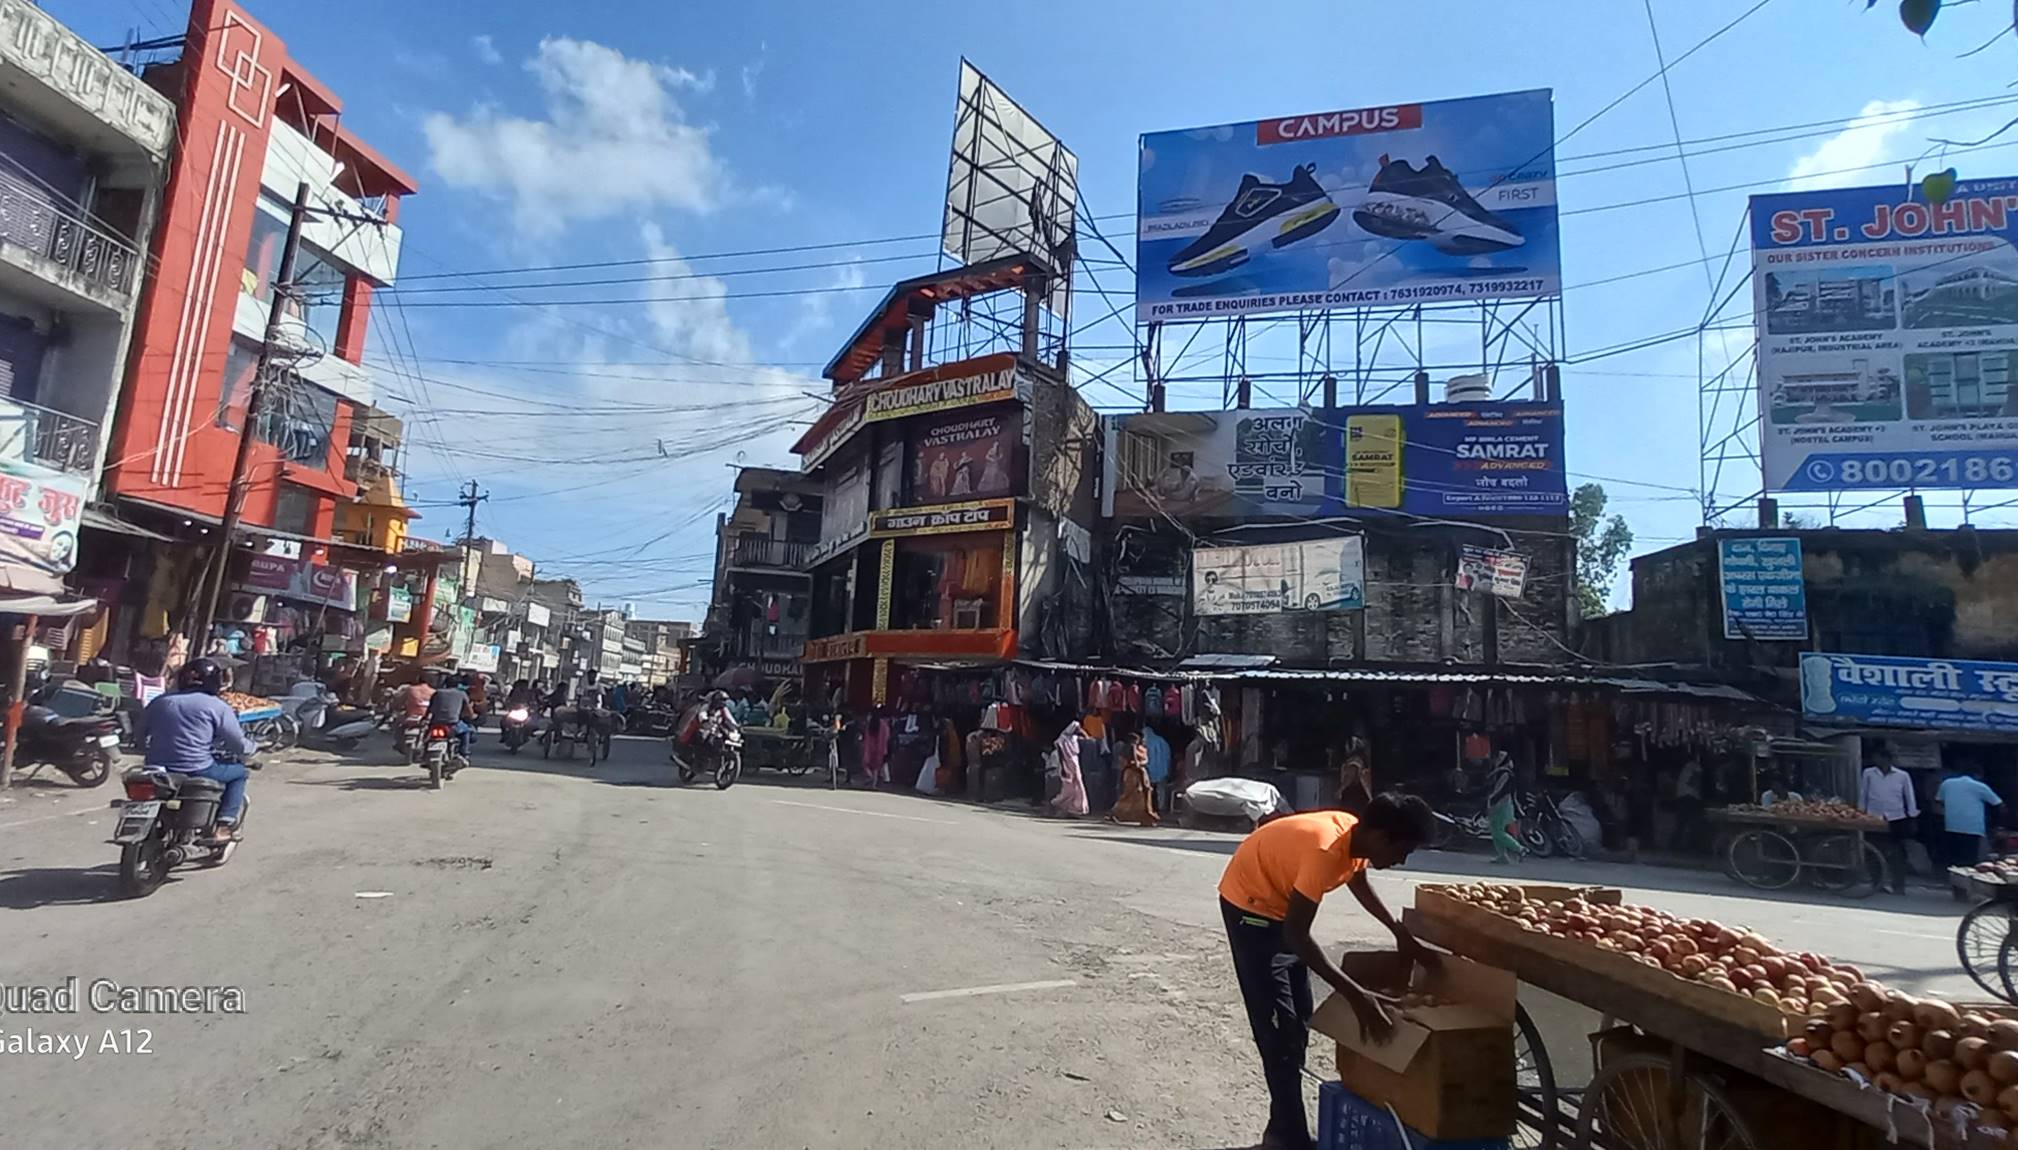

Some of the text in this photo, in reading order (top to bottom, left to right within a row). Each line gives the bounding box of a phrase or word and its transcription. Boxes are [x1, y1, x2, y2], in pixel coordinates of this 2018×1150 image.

[1278, 108, 1399, 138] CAMPUS
[1498, 187, 1540, 201] FIRST
[1771, 208, 1849, 245] ST.
[1767, 254, 1792, 264] OUR
[1795, 250, 1838, 262] SISTER
[1841, 247, 1900, 259] CONCERN
[1152, 305, 1174, 316] FOR
[1177, 302, 1212, 313] TRADE
[1215, 296, 1275, 310] ENQUIRIES
[1278, 294, 1322, 306] PLEASE
[1325, 290, 1380, 303] CONTACT
[1469, 279, 1544, 294] 7319932217
[868, 369, 1016, 411] CHOUDHARY VASTRALAY
[923, 426, 1001, 447] VASTRALAY
[931, 417, 996, 437] CHOUDHARY
[1456, 443, 1549, 459] SAMRAT
[1480, 461, 1546, 471] ADVANCED
[1831, 655, 1964, 692] वैशाली
